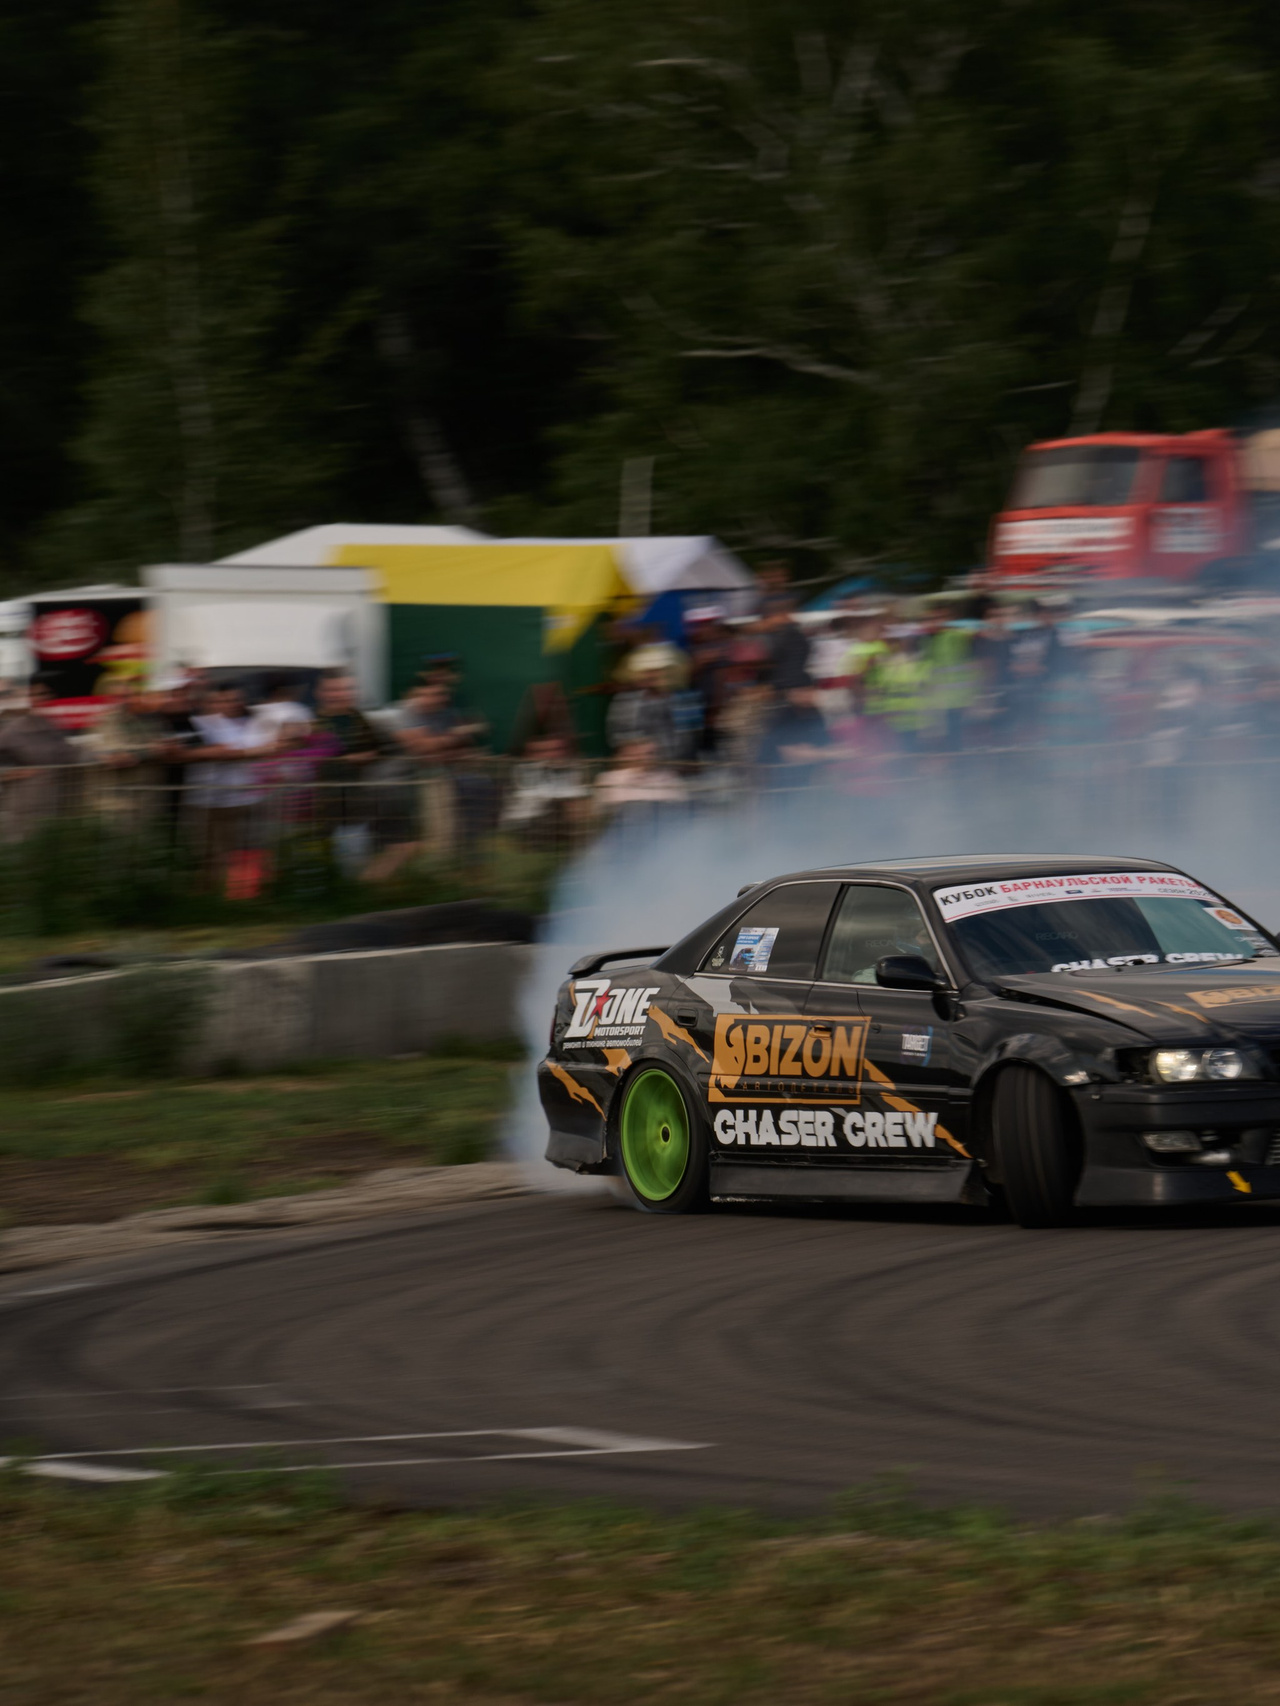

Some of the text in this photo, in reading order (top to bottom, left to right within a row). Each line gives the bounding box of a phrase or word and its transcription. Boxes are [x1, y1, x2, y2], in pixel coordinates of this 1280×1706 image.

[939, 886, 997, 906] КУБОК
[1000, 874, 1132, 893] БАРНАУЛЬСКОЙ
[1136, 876, 1202, 889] РАКЕТЫ
[594, 1026, 646, 1037] MOTORSPORT
[744, 1024, 863, 1077] BIZON
[714, 1108, 938, 1148] CHASER CREW
